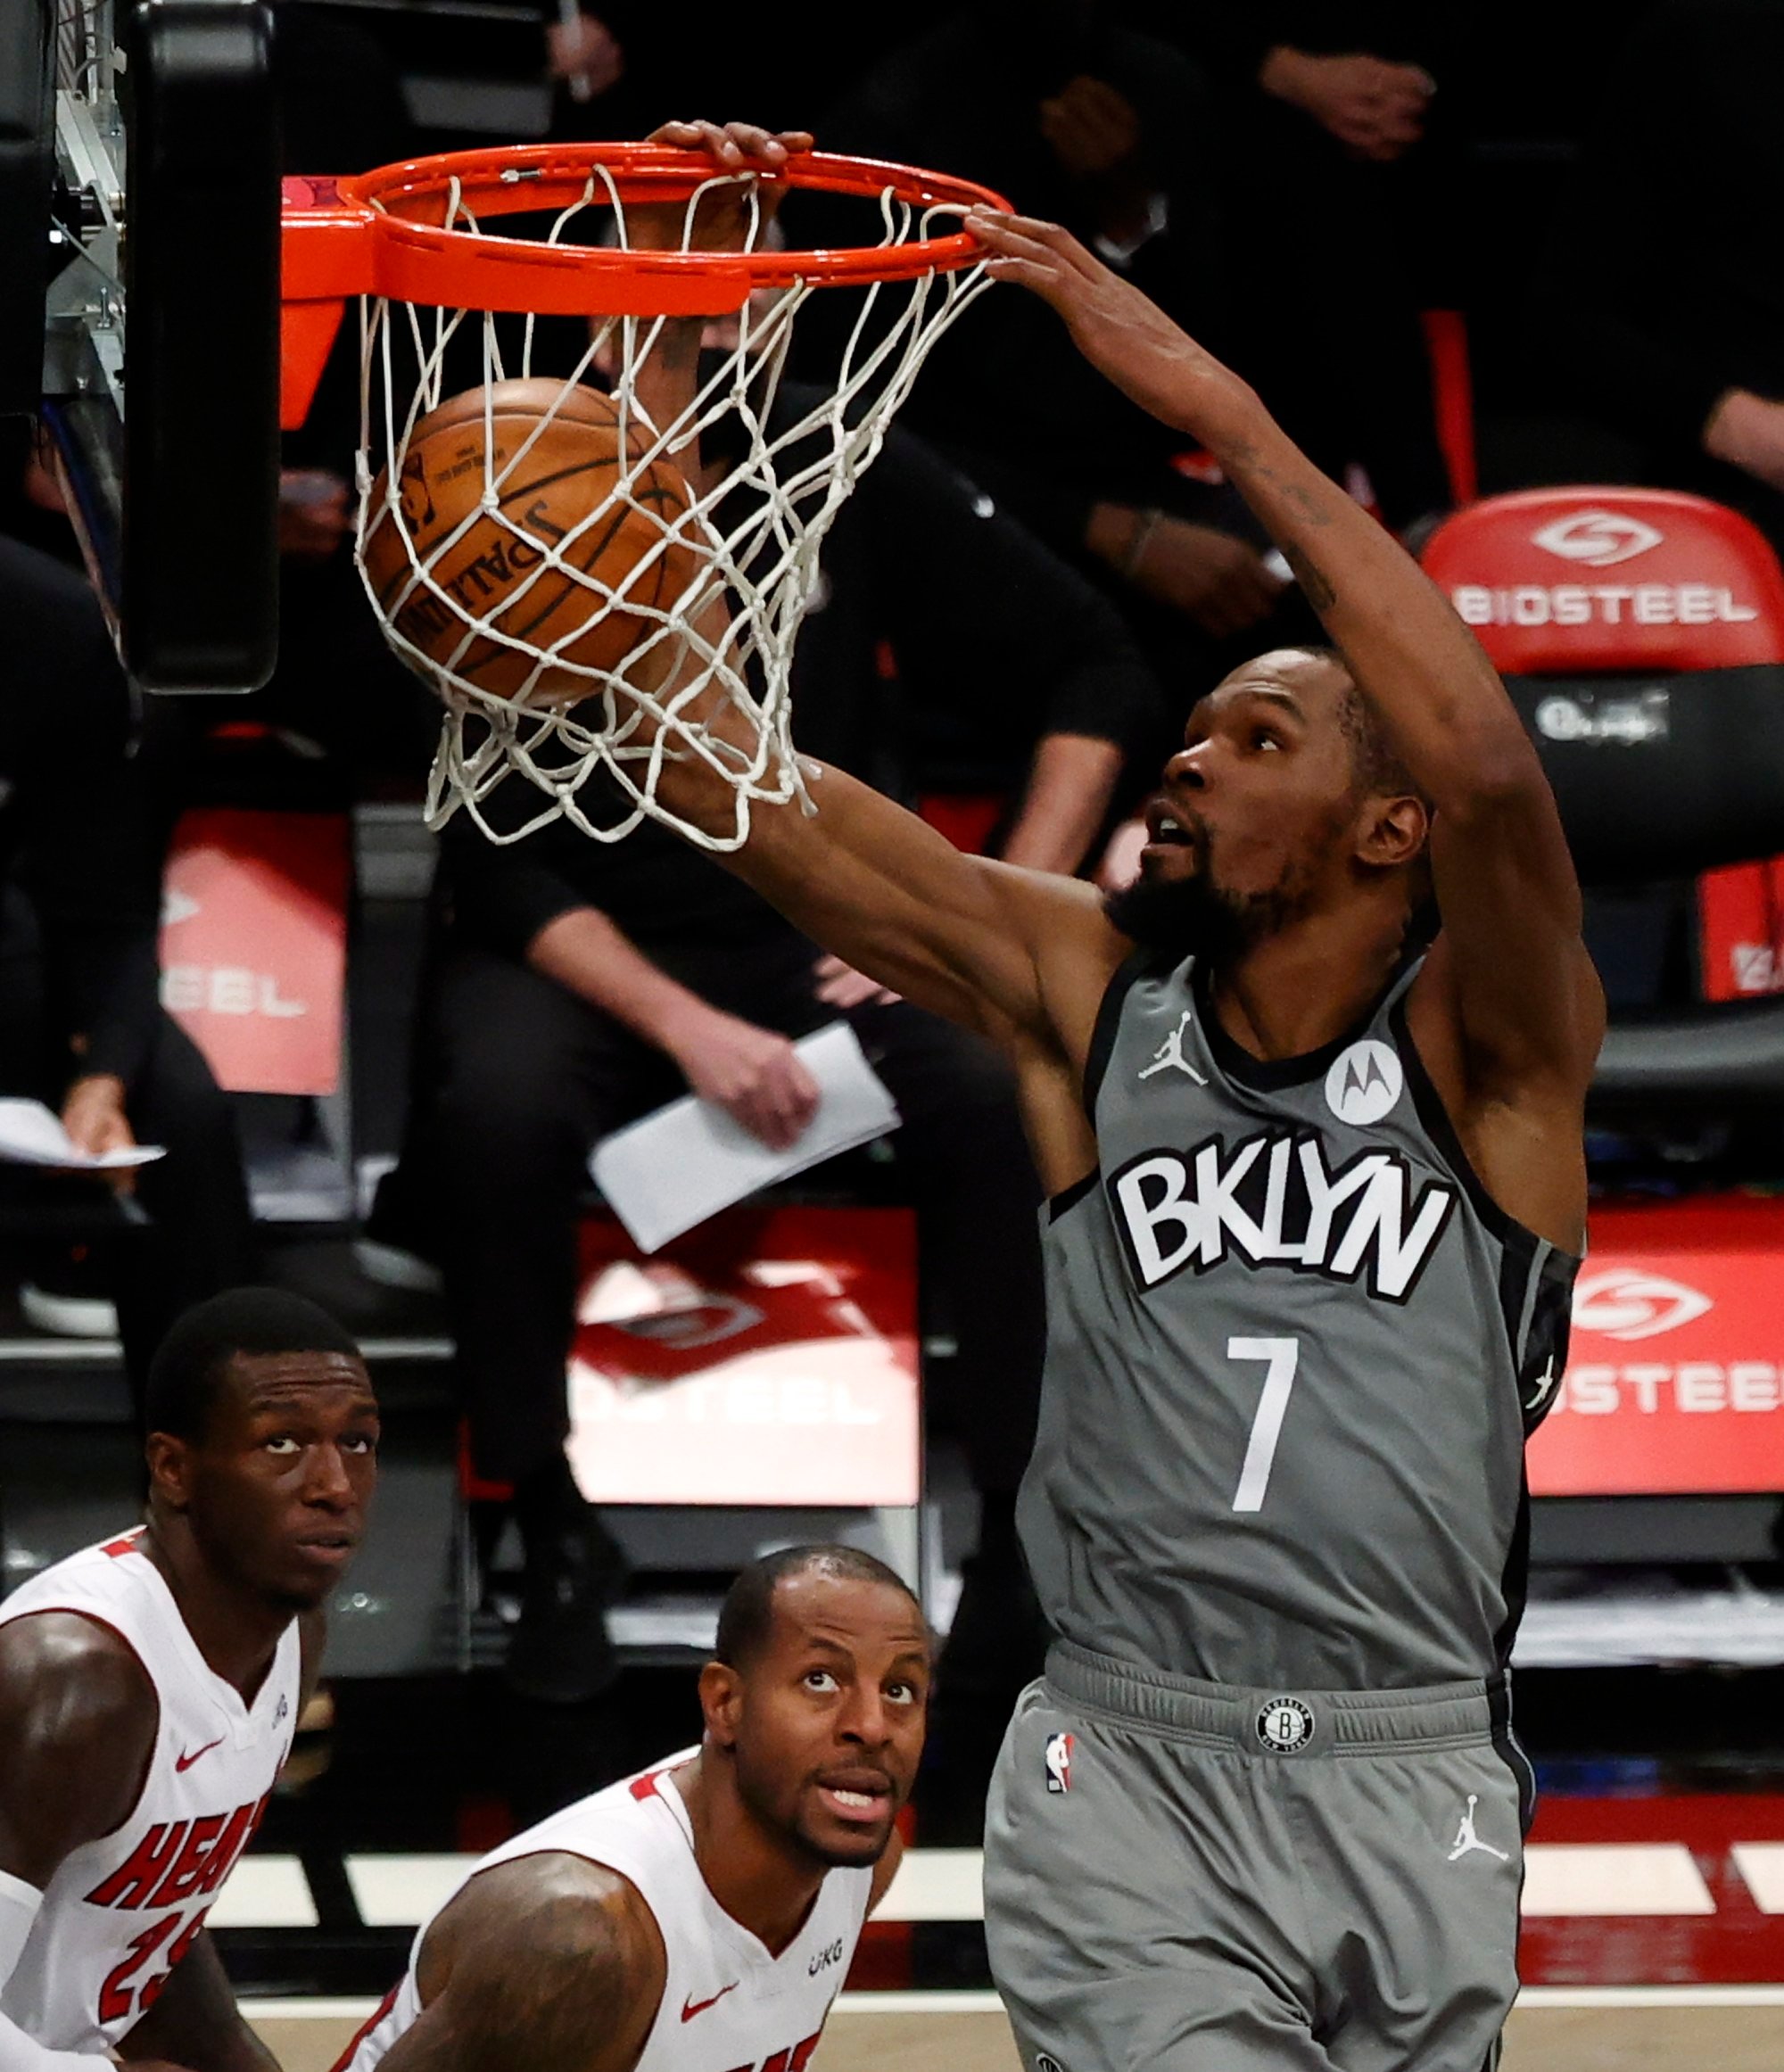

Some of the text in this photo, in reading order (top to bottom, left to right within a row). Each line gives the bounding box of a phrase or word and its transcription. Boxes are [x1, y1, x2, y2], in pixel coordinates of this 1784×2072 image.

[1451, 585, 1758, 625] BIOSTEEL
[1113, 1134, 1453, 1299] BKLYN
[1550, 1361, 1784, 1415] STEE
[1227, 1337, 1299, 1512] 7
[1279, 1712, 1292, 1739] B
[807, 1937, 843, 1977] UKG
